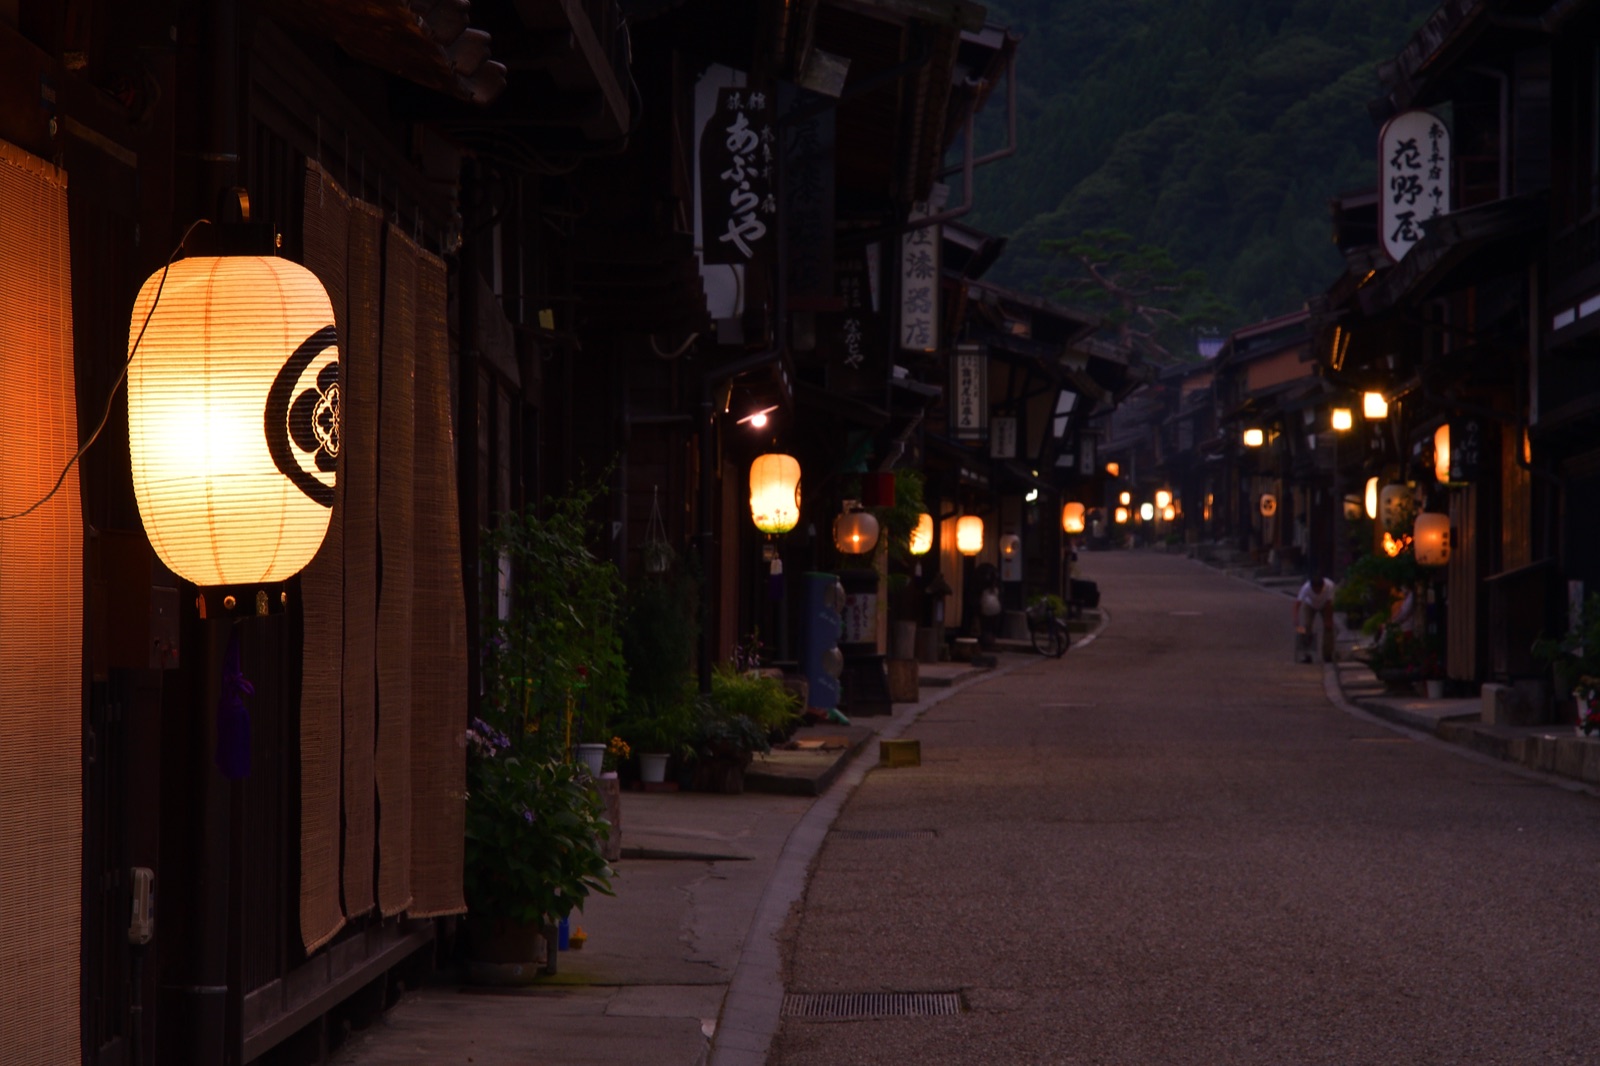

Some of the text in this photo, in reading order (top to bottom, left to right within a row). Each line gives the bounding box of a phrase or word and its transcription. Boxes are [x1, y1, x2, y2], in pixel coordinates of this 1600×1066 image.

[719, 111, 767, 259] あぶらや
[1390, 137, 1425, 242] 花野屋
